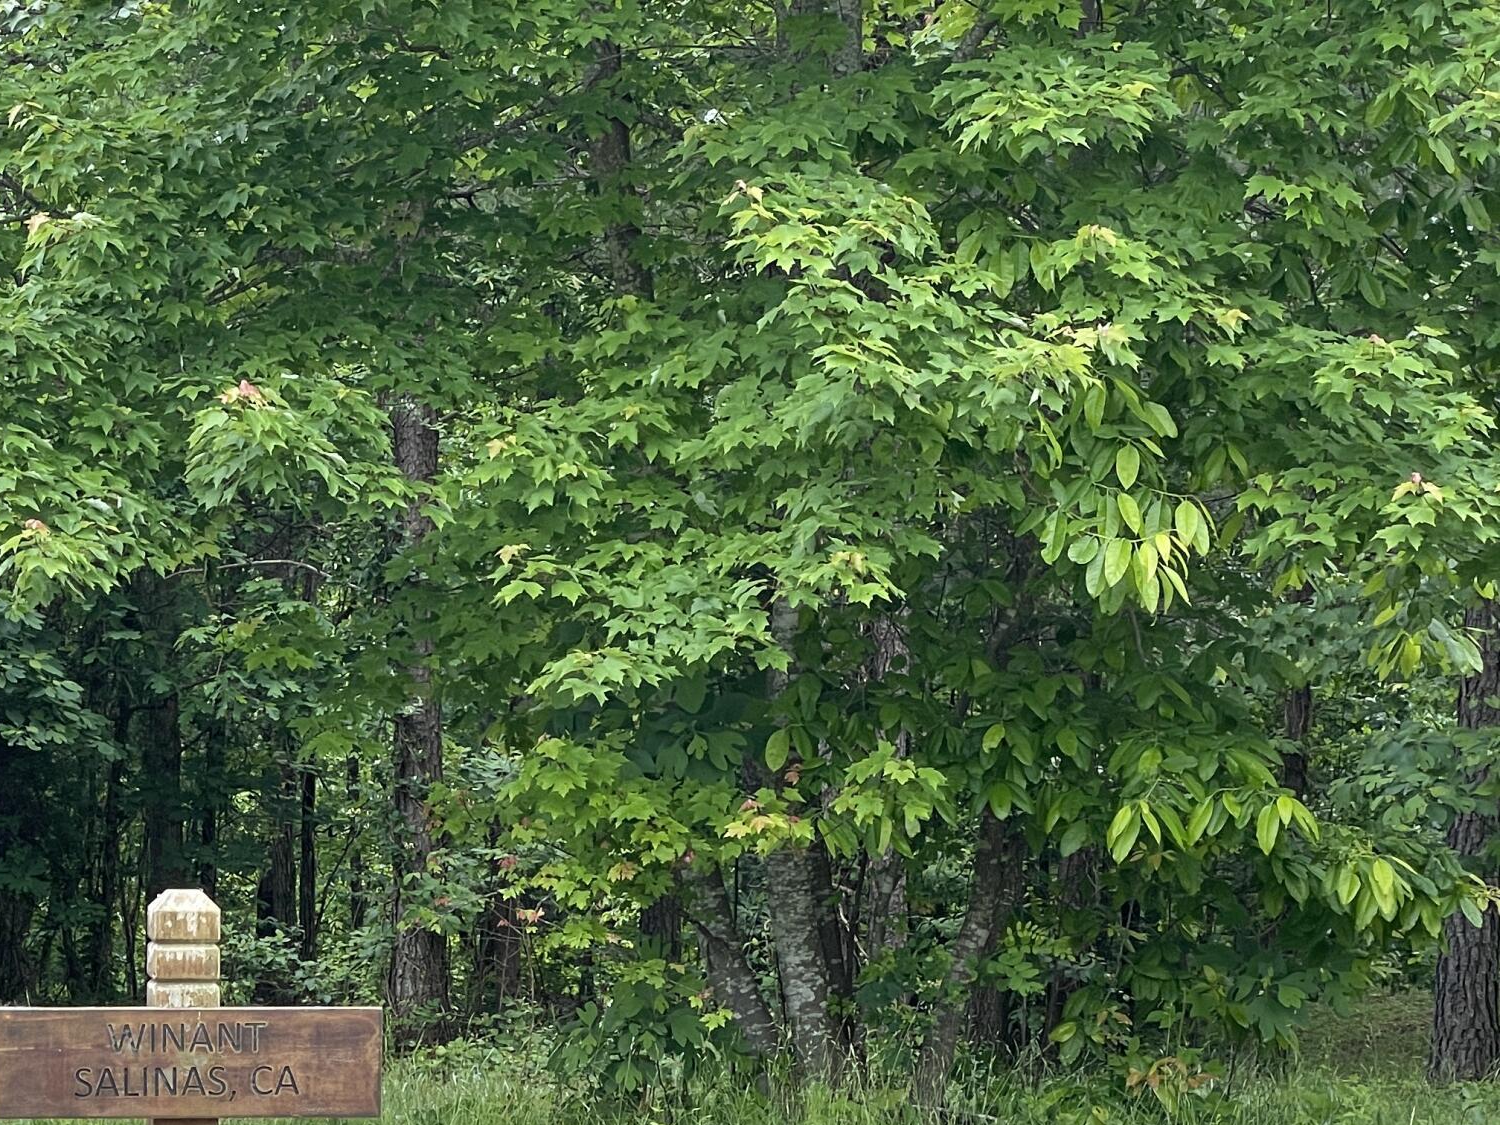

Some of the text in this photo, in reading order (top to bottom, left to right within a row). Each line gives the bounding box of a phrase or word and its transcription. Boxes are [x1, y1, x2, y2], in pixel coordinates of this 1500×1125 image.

[108, 1021, 268, 1054] WINANT
[74, 1065, 300, 1101] SALINAS, CA
